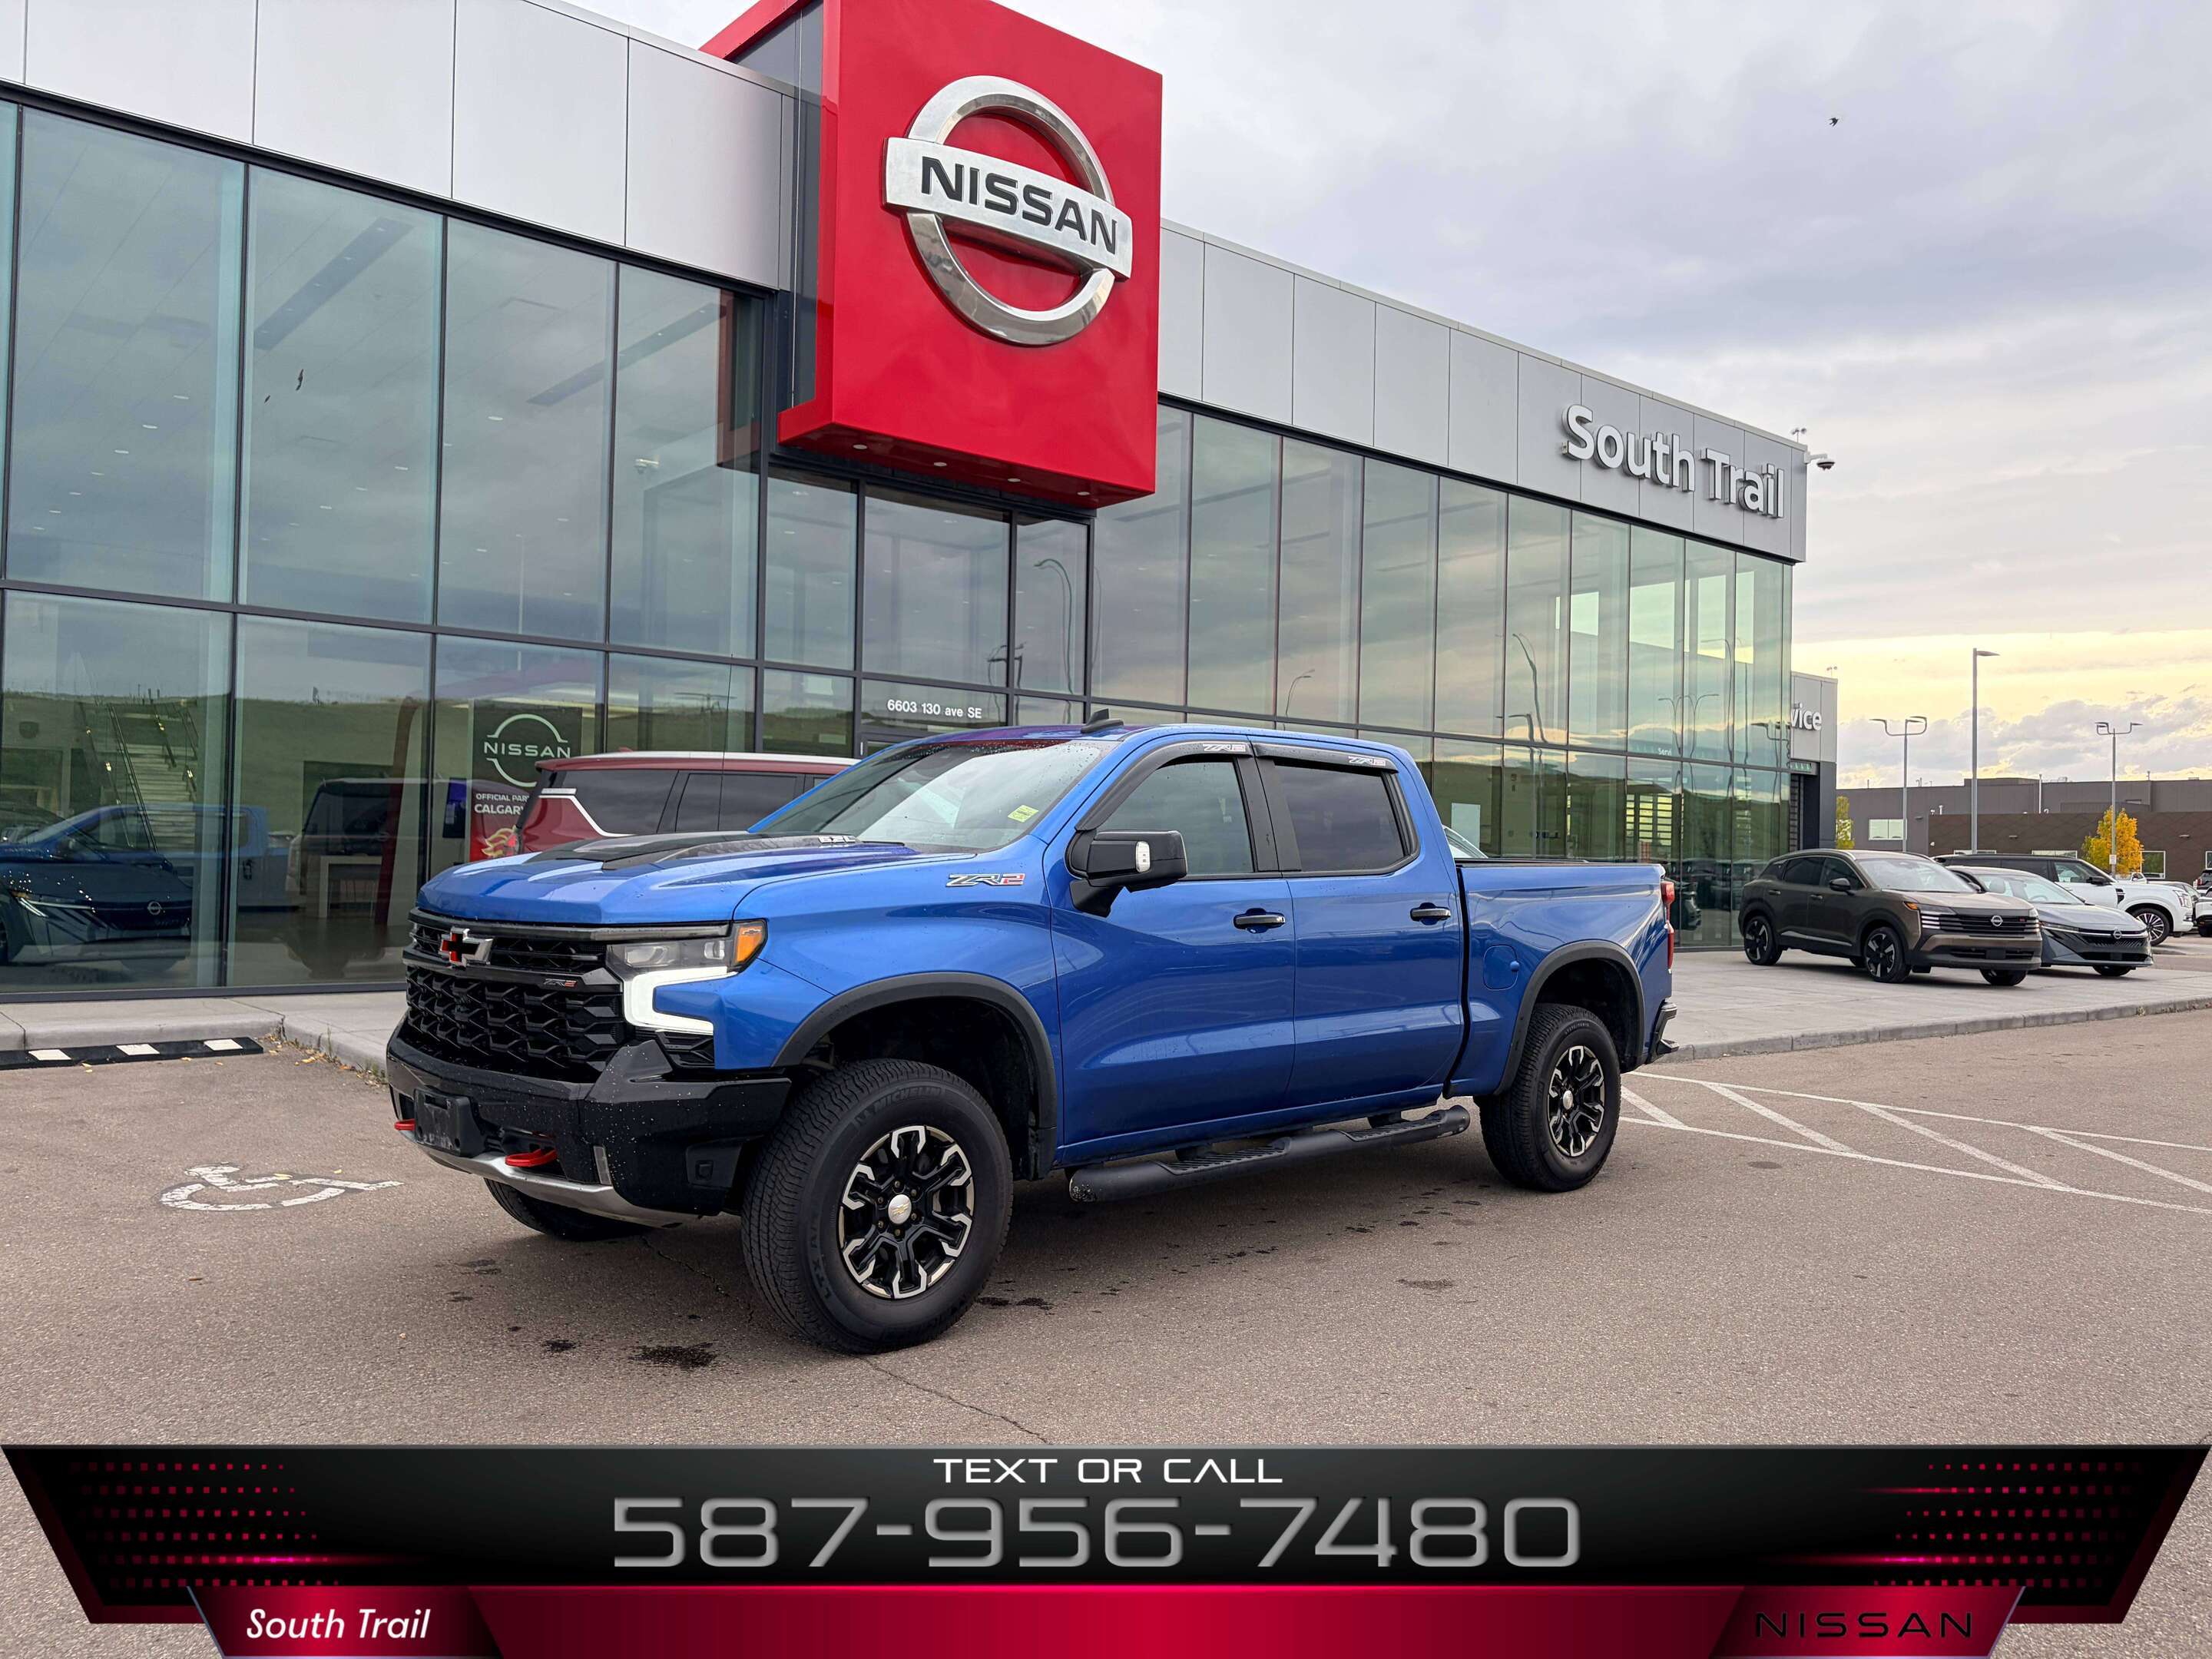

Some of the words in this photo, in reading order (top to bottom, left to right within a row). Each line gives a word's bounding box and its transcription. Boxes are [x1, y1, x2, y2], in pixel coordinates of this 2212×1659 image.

[921, 156, 1117, 255] NISSAN
[1561, 404, 1696, 492] South
[1700, 448, 1785, 518] Trail
[887, 699, 918, 713] 6603
[922, 703, 941, 715] 130
[945, 707, 963, 717] ave
[967, 707, 982, 719] SE
[484, 741, 571, 759] NISSAN
[475, 793, 511, 802] OFFICIAL
[512, 794, 530, 803] PAR
[474, 803, 524, 815] CALGAR
[946, 873, 1025, 886] ZR2
